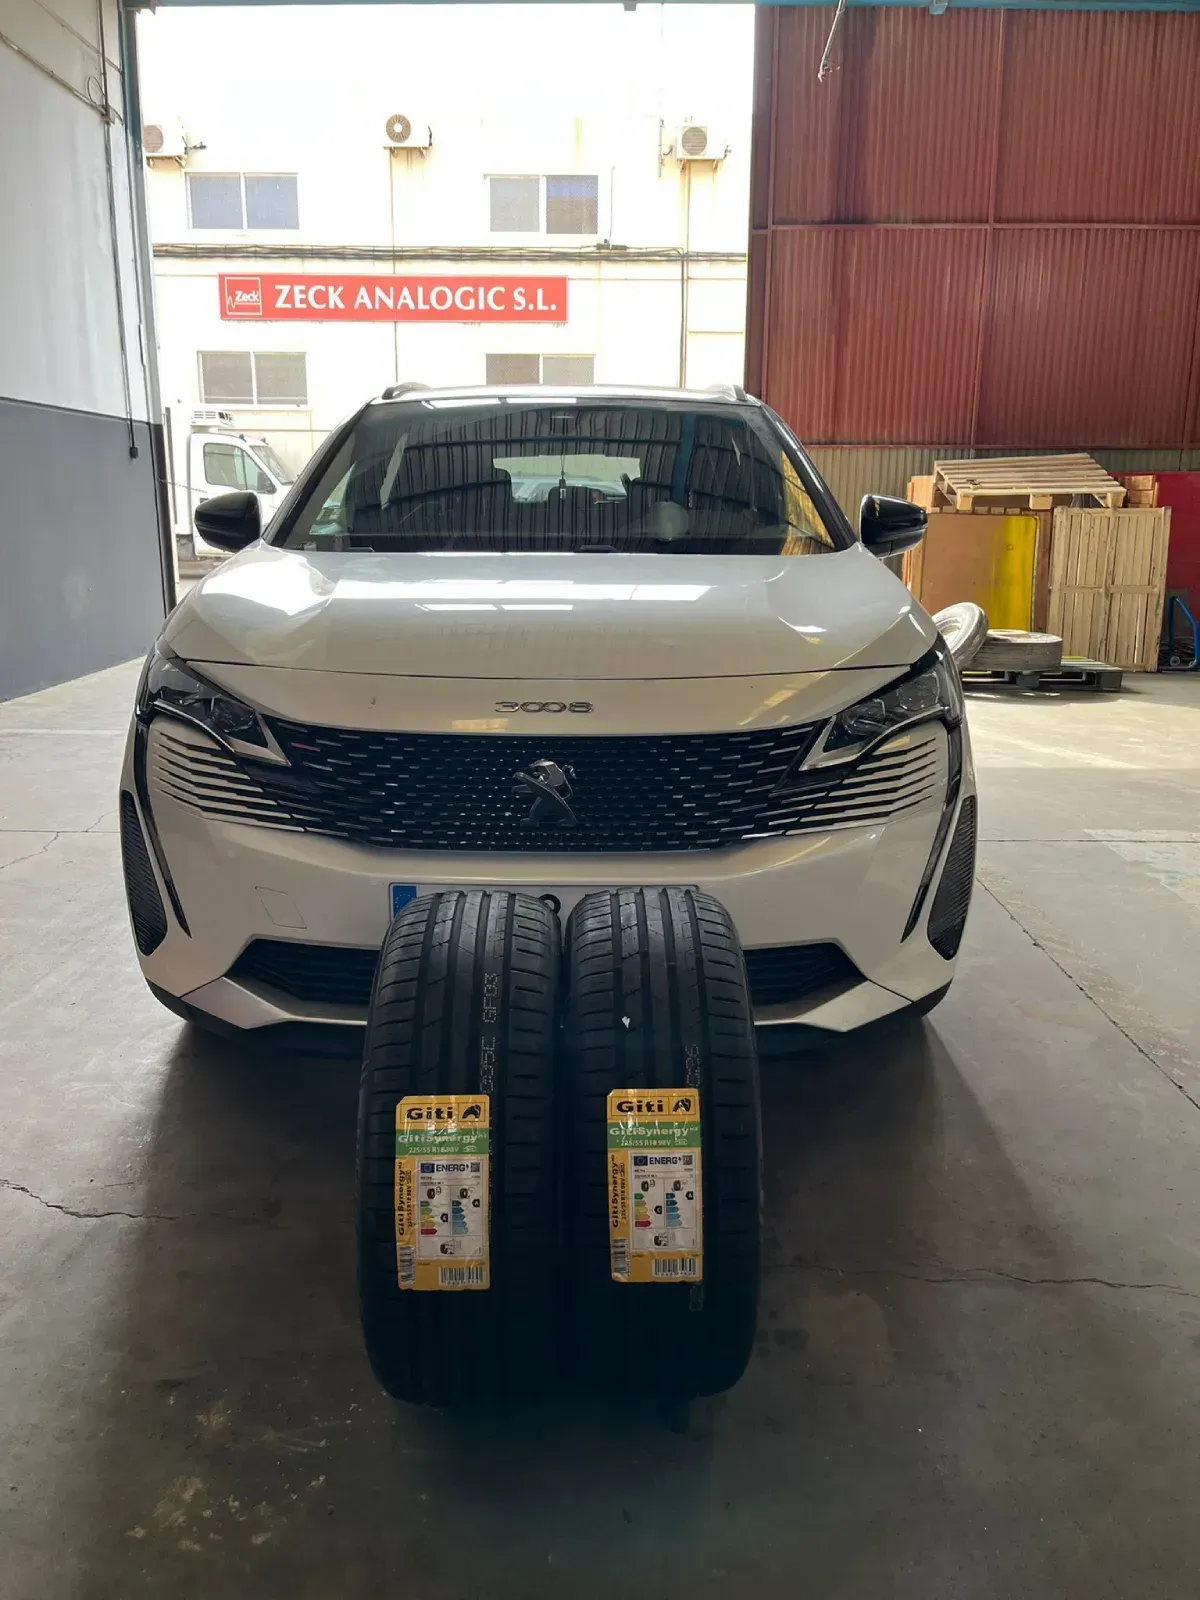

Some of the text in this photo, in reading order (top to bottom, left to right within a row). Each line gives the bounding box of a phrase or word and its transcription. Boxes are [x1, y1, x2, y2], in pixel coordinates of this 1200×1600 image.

[234, 290, 261, 303] Zeck
[274, 284, 558, 311] ZECK ANALOGIC S.L.
[494, 701, 594, 713] 3008
[616, 1100, 664, 1113] Giti
[406, 1107, 453, 1120] Giti
